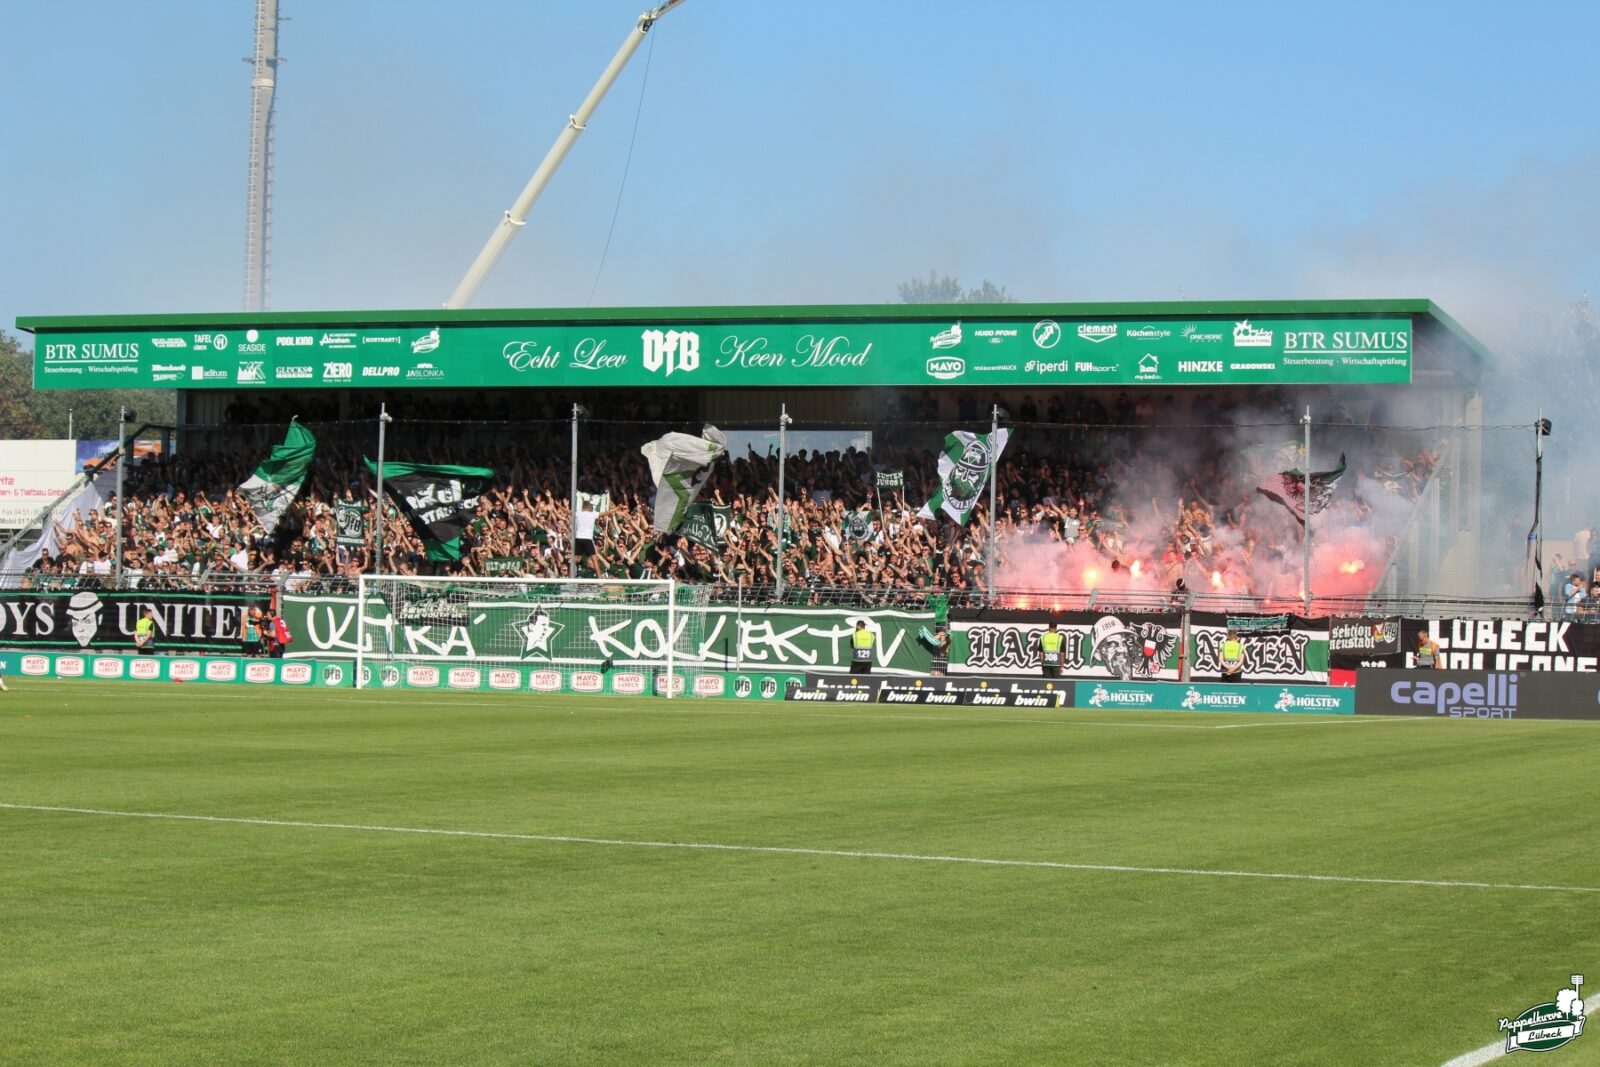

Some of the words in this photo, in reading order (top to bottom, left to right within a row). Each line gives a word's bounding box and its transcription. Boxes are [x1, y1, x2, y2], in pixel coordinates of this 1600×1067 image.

[1078, 323, 1117, 333] clement
[1127, 329, 1171, 338] Küchenstyle
[194, 335, 212, 343] TAFEL
[1284, 331, 1325, 349] BTR
[1332, 331, 1408, 349] SUMUS
[45, 344, 77, 359] BTR
[81, 343, 139, 359] SUMUS
[238, 344, 266, 352] SEASIDE
[715, 335, 786, 368] Keen
[791, 334, 873, 368] Mood
[502, 340, 560, 372] Echt
[569, 337, 629, 370] Leev
[930, 361, 961, 371] MAYO
[1036, 360, 1068, 374] iperdi
[1178, 361, 1223, 372] HINZKE
[1283, 357, 1334, 367] Steuerberatung
[1341, 357, 1407, 367] Wirtschaftsprüfung
[44, 366, 82, 374] Steuerberatung
[88, 365, 138, 374] Wirtschaftsprüfung
[0, 602, 55, 636] YS
[1332, 622, 1372, 639] sektion
[588, 614, 906, 667] KOLLEKTV
[1329, 637, 1375, 650] neustadt
[857, 650, 871, 658] 129
[794, 690, 827, 700] bwin
[836, 690, 869, 701] bwin
[887, 692, 918, 702] bwin
[926, 692, 957, 703] bwin
[1111, 693, 1153, 703] HOLSTEN
[1391, 673, 1518, 714] capelli
[972, 694, 1007, 705] bwin
[1014, 695, 1049, 706] bwin
[1203, 695, 1246, 705] HOLSTEN
[1296, 698, 1341, 707] HOLSTEN
[1449, 707, 1517, 719] SPORT
